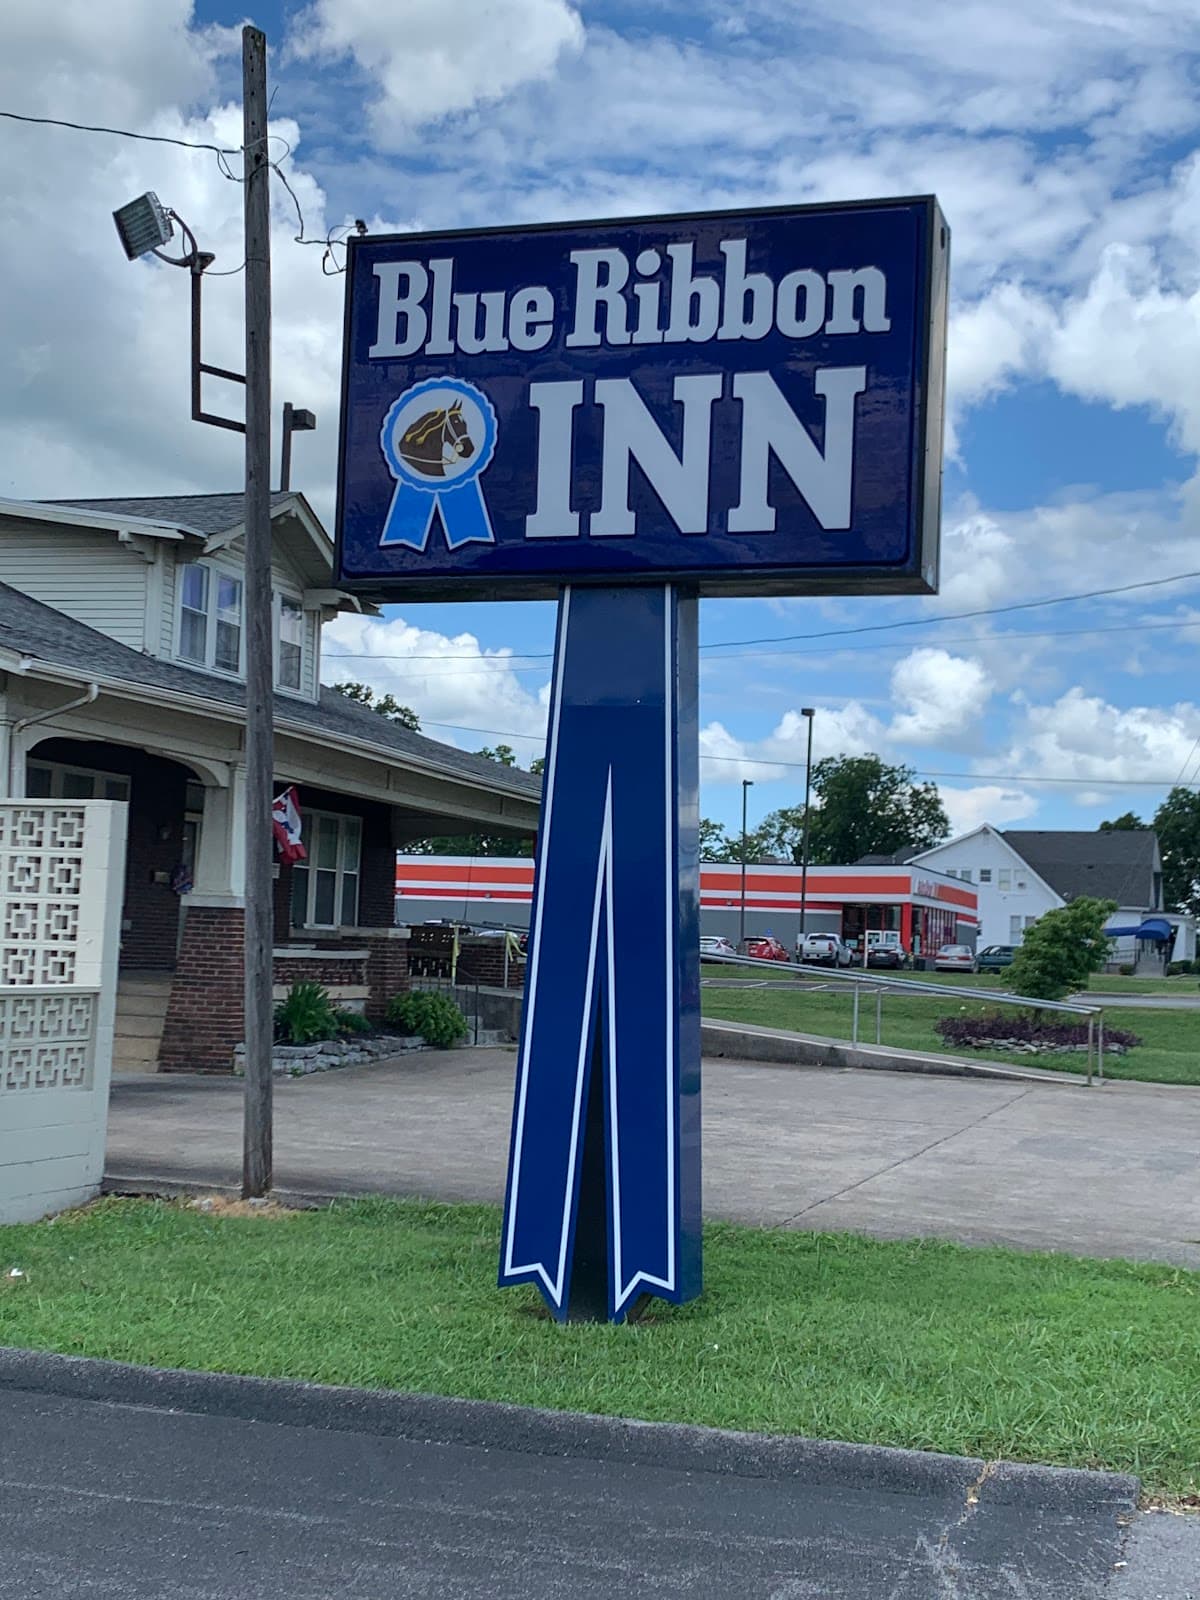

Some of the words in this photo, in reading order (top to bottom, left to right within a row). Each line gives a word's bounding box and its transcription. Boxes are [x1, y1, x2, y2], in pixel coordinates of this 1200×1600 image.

[368, 257, 555, 359] Blue
[565, 237, 892, 348] Ribbon
[524, 365, 867, 539] INN
